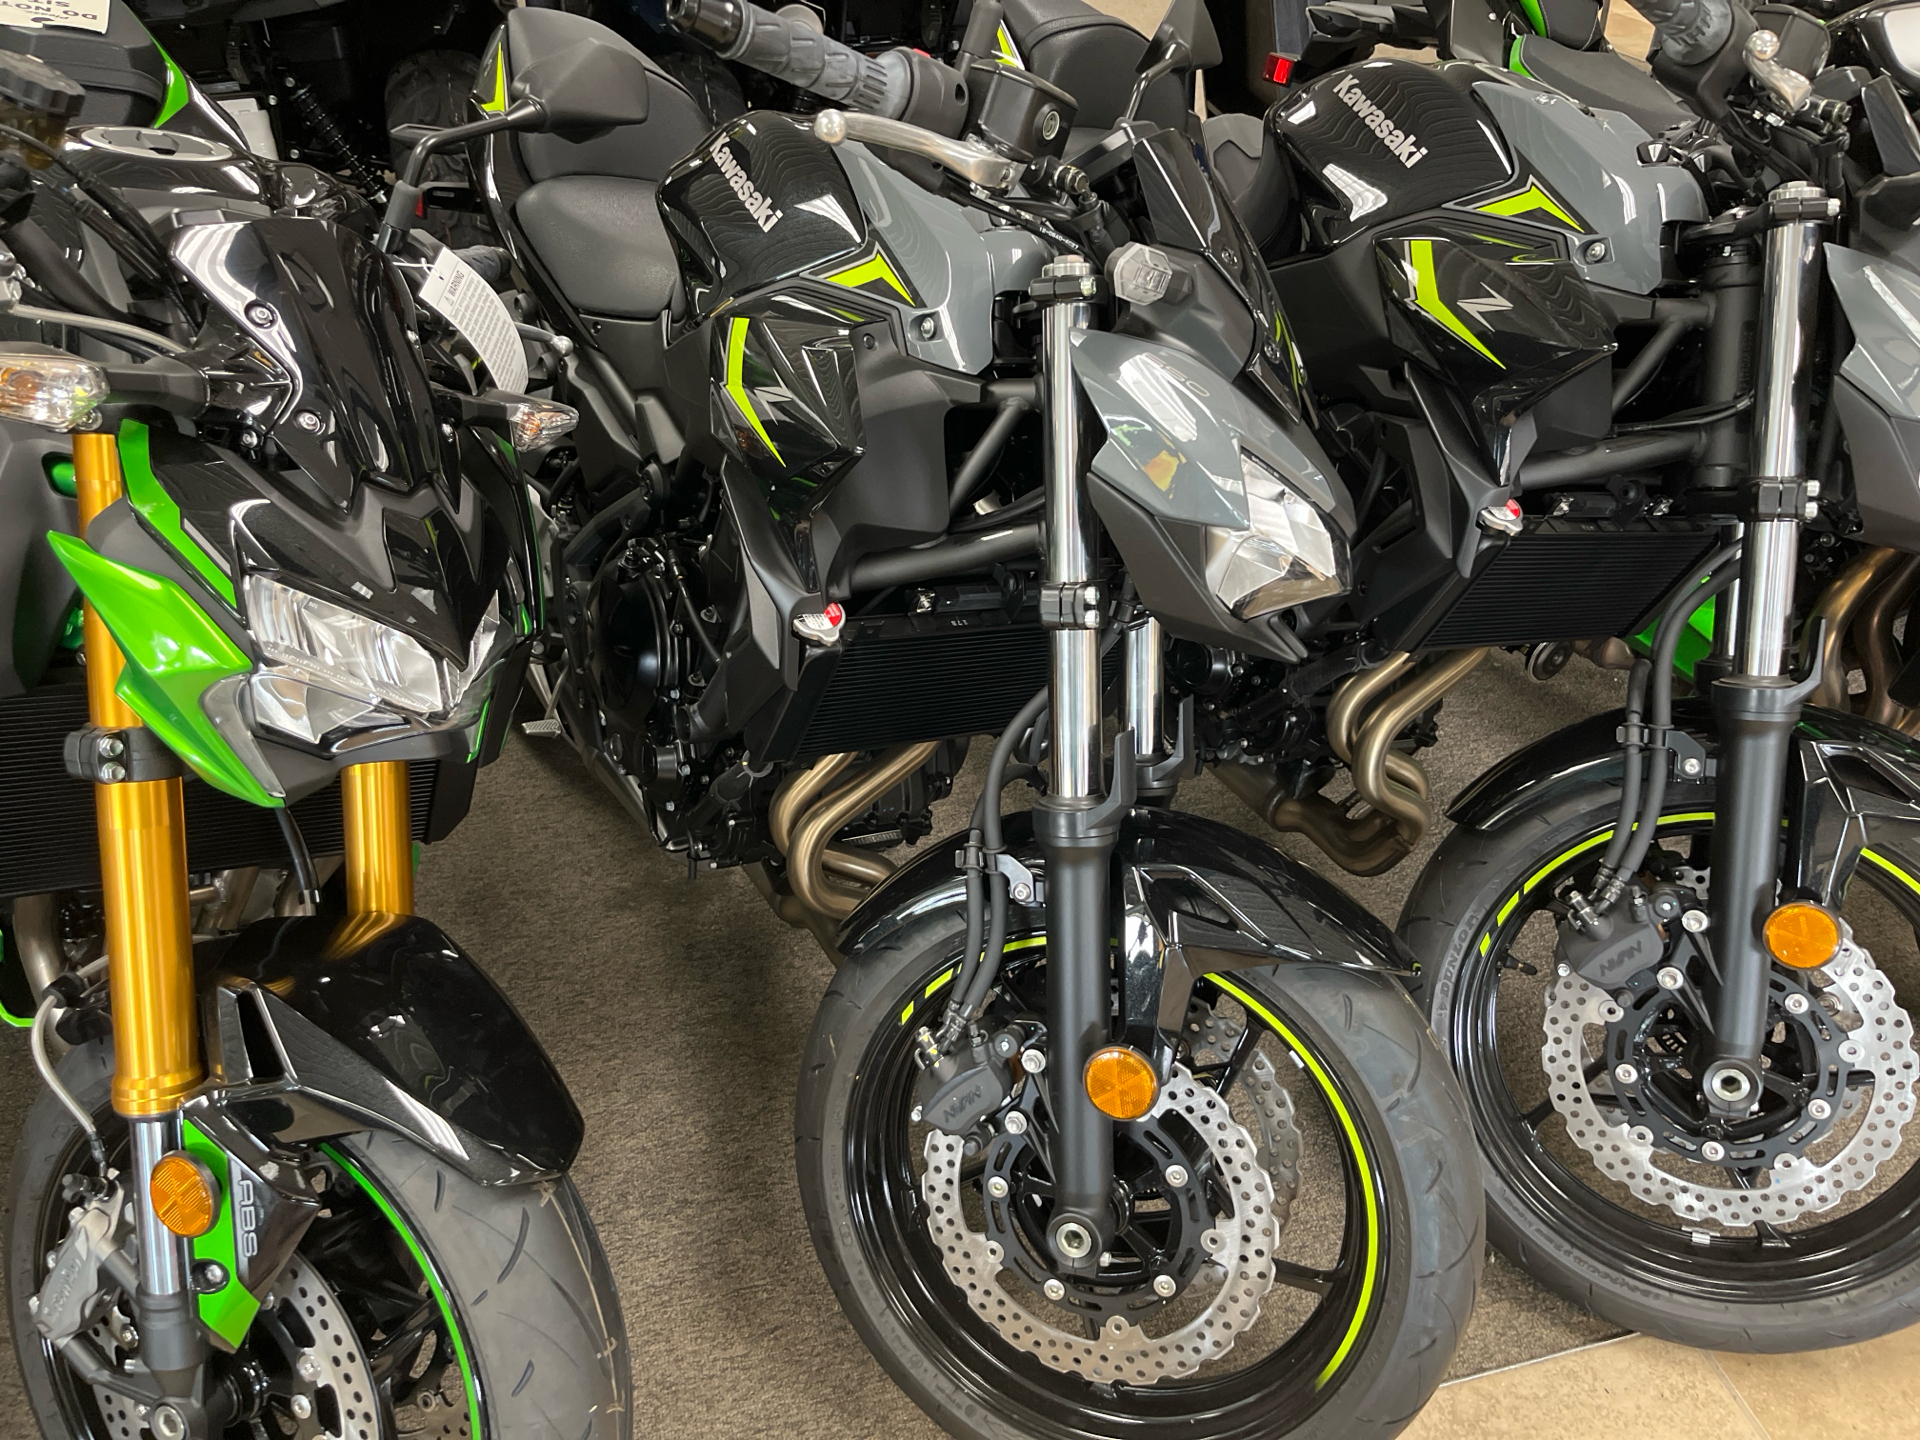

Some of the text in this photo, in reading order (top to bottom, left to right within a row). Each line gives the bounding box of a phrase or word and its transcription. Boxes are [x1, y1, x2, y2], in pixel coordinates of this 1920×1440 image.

[62, 10, 97, 20] DO
[1332, 73, 1428, 169] Kawasaki
[709, 131, 783, 233] Kawasaki
[448, 270, 465, 297] WARNING
[1440, 914, 1479, 998] DUNLOP
[238, 1180, 258, 1257] ABS
